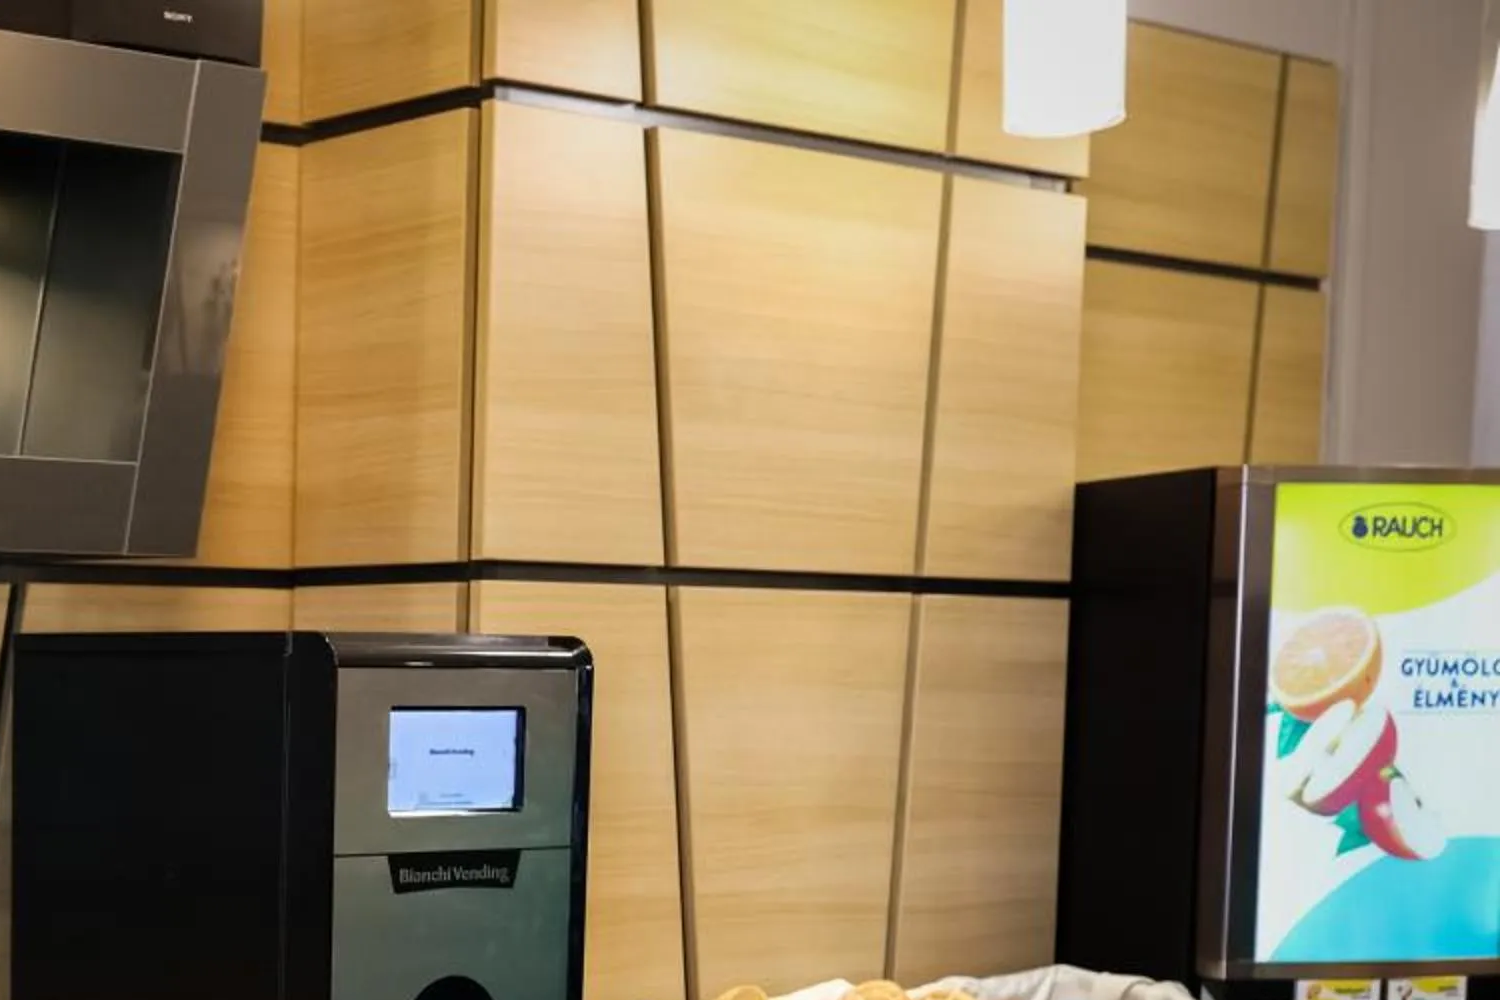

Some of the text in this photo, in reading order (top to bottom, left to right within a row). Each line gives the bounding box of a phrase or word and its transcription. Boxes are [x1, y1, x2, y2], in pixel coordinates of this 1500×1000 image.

[1372, 515, 1443, 538] RAUCH
[399, 863, 510, 884] Bianchi Vending
